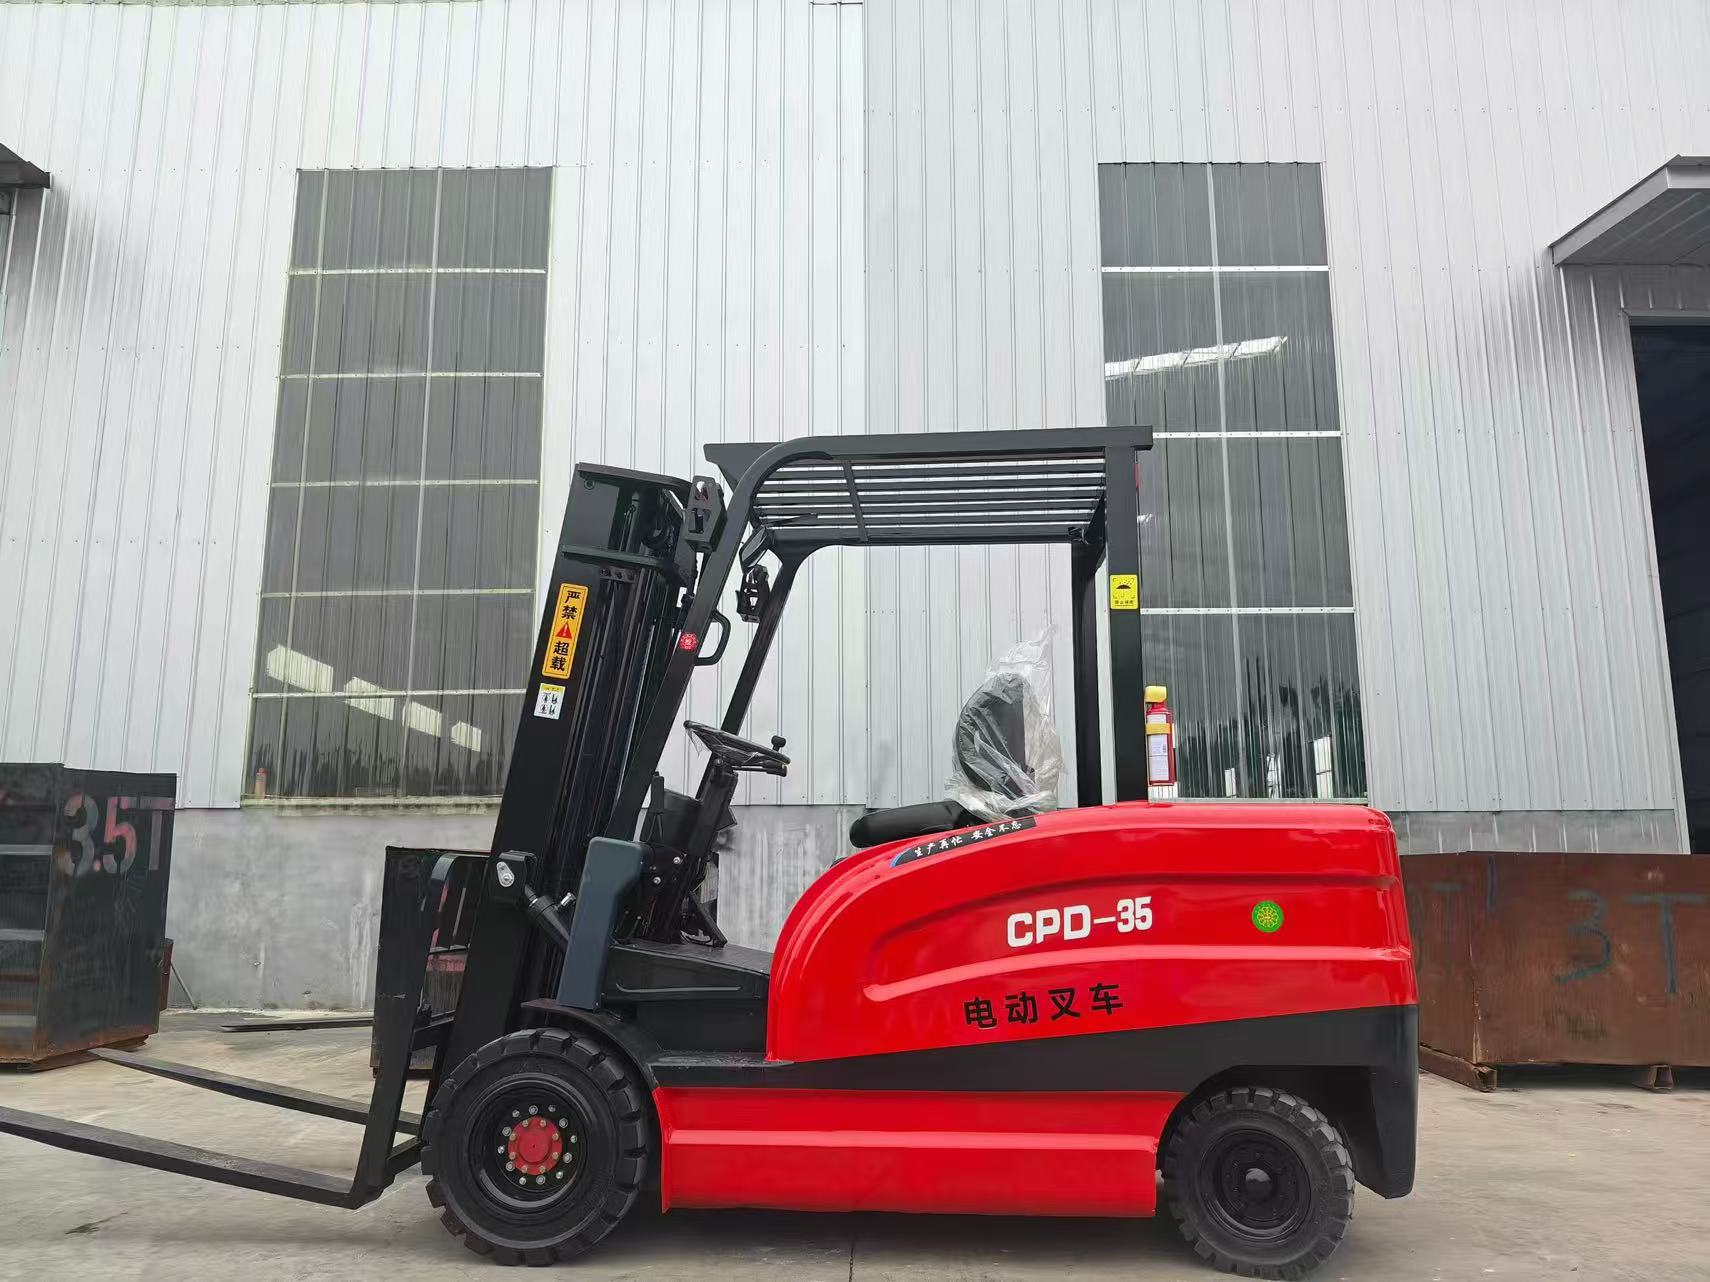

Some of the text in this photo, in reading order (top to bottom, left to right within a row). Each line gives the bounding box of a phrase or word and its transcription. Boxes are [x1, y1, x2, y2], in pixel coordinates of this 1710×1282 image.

[562, 591, 581, 619] 严禁
[550, 642, 569, 671] 超载
[56, 792, 175, 876] 3.5T
[914, 836, 963, 857] 生产再忙
[1008, 897, 1153, 947] CPD-35
[965, 983, 1123, 1029] 电动叉车
